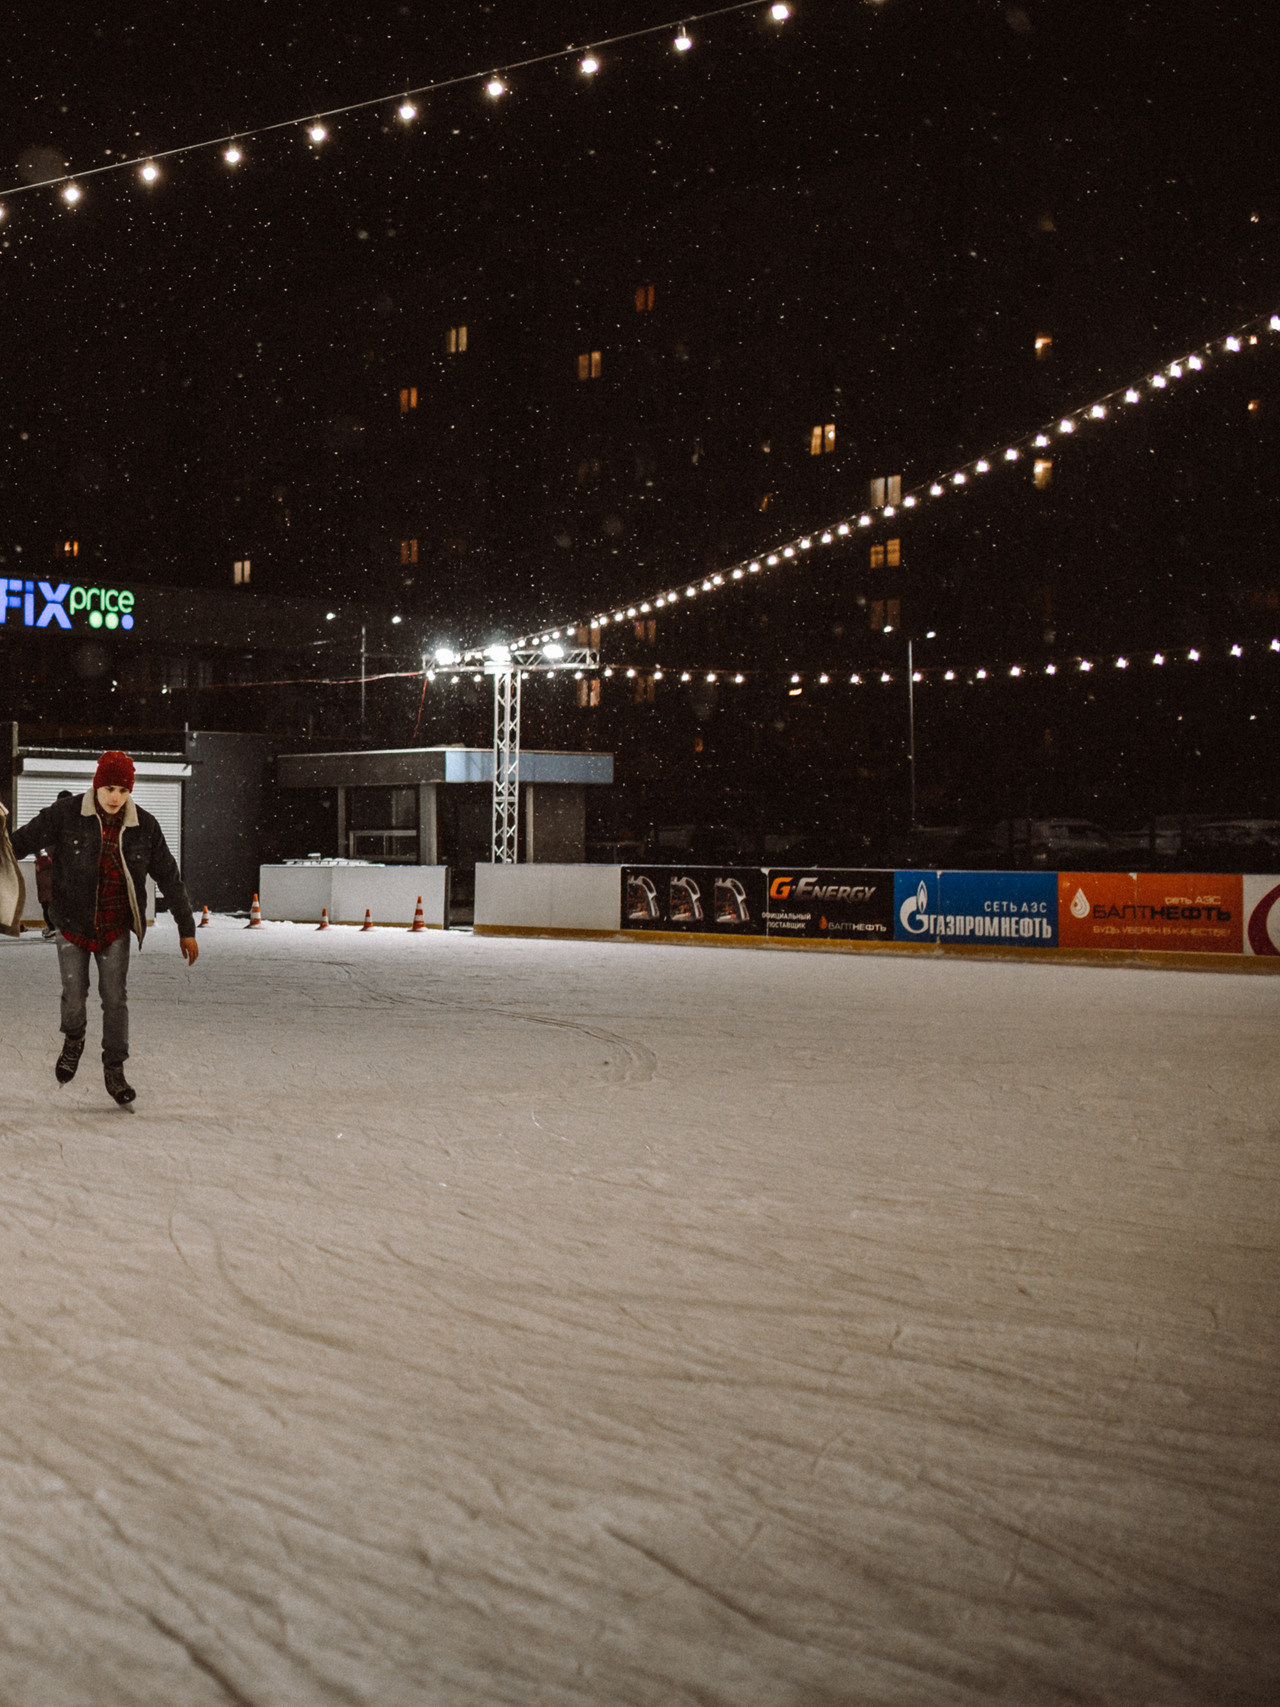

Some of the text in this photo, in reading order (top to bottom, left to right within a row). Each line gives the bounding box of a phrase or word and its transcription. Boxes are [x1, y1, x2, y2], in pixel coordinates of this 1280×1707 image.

[1195, 896, 1222, 905] АЗС
[984, 901, 1048, 914] СЕТЬ АЗС
[761, 911, 812, 920] ОФИЦИАЛЬНЫЙ
[1093, 905, 1232, 922] БАЛТНЕФТЬ
[767, 921, 806, 930] ПОСТАВЩИК
[828, 922, 887, 932] БАЛТНЕФТЬ
[929, 914, 1053, 940] ГАЗПРОМНЕФТЬ
[1122, 926, 1161, 936] УВЕРЕН
